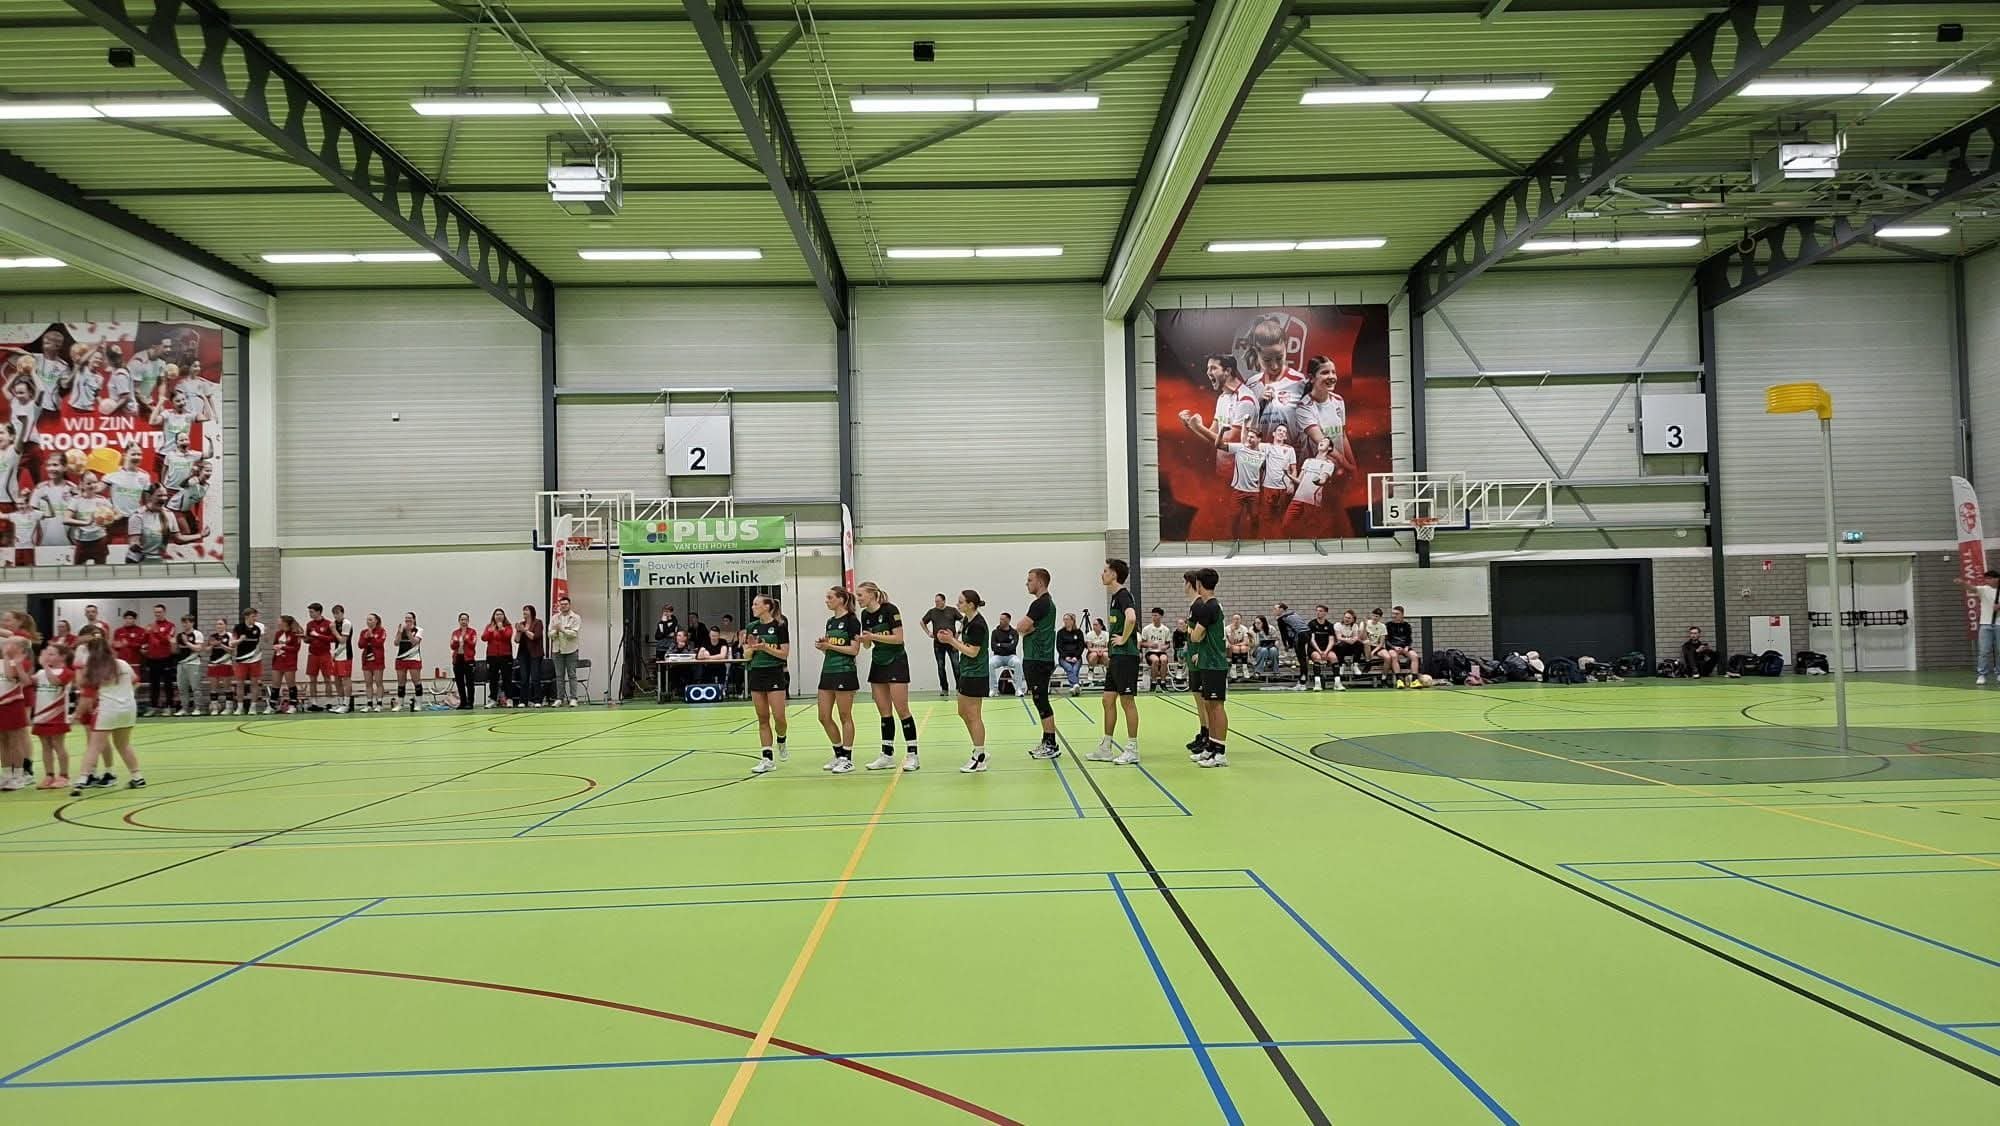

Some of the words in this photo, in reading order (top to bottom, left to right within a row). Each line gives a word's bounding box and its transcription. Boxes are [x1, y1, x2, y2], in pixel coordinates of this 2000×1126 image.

[63, 417, 94, 431] WIJ
[99, 416, 135, 431] ZIJN
[40, 431, 164, 450] ROOD-WIT
[1667, 425, 1683, 448] 3
[690, 447, 706, 470] 2
[1390, 505, 1399, 518] 5
[673, 519, 759, 542] PLUS
[648, 559, 711, 570] Bouwbedrijf
[649, 572, 695, 586] Frank
[699, 570, 759, 584] Wielink
